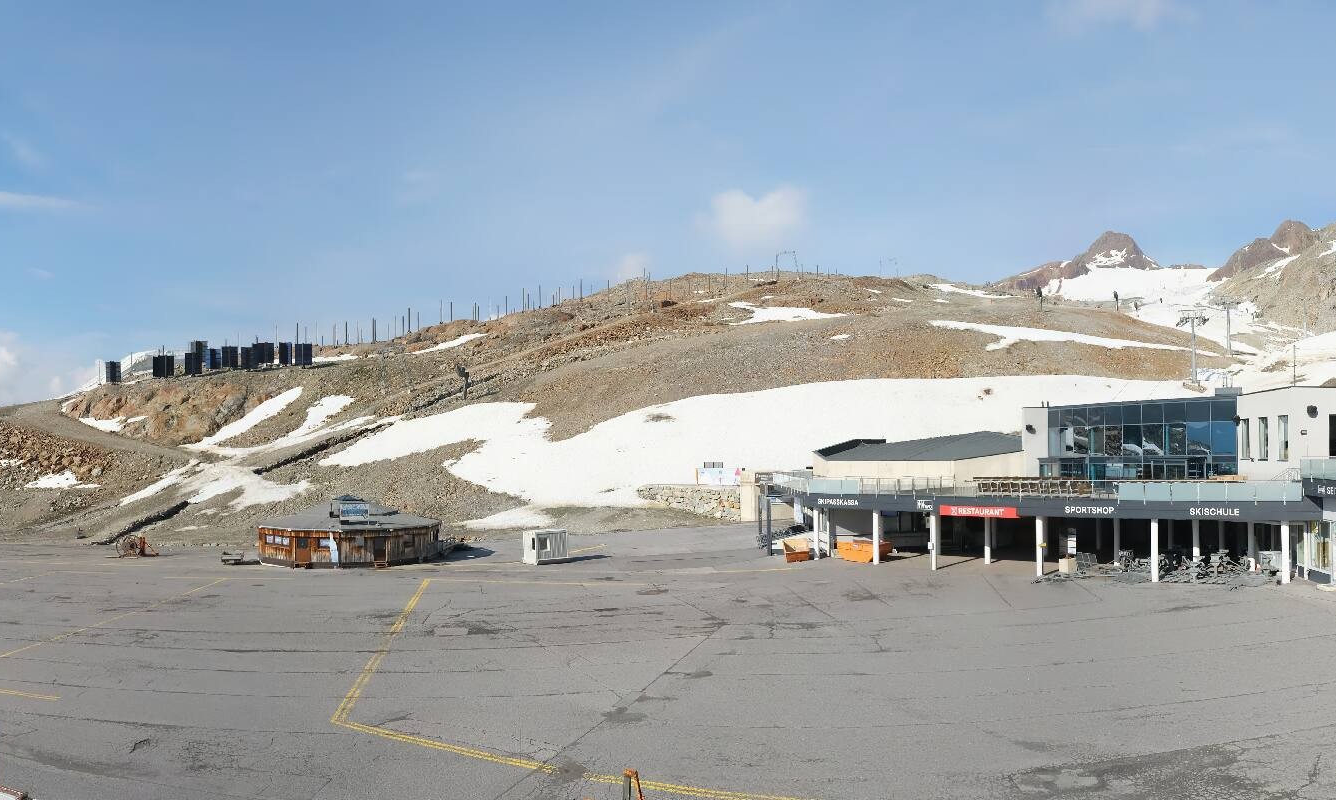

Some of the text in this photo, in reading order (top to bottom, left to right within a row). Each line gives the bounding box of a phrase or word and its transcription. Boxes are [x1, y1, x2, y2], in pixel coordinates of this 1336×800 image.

[817, 498, 859, 506] SKIPASSKASSA
[958, 507, 1005, 516] RESTAURANT
[1064, 506, 1115, 515] SPORTSHOP
[1189, 507, 1240, 516] SKISCHULE
